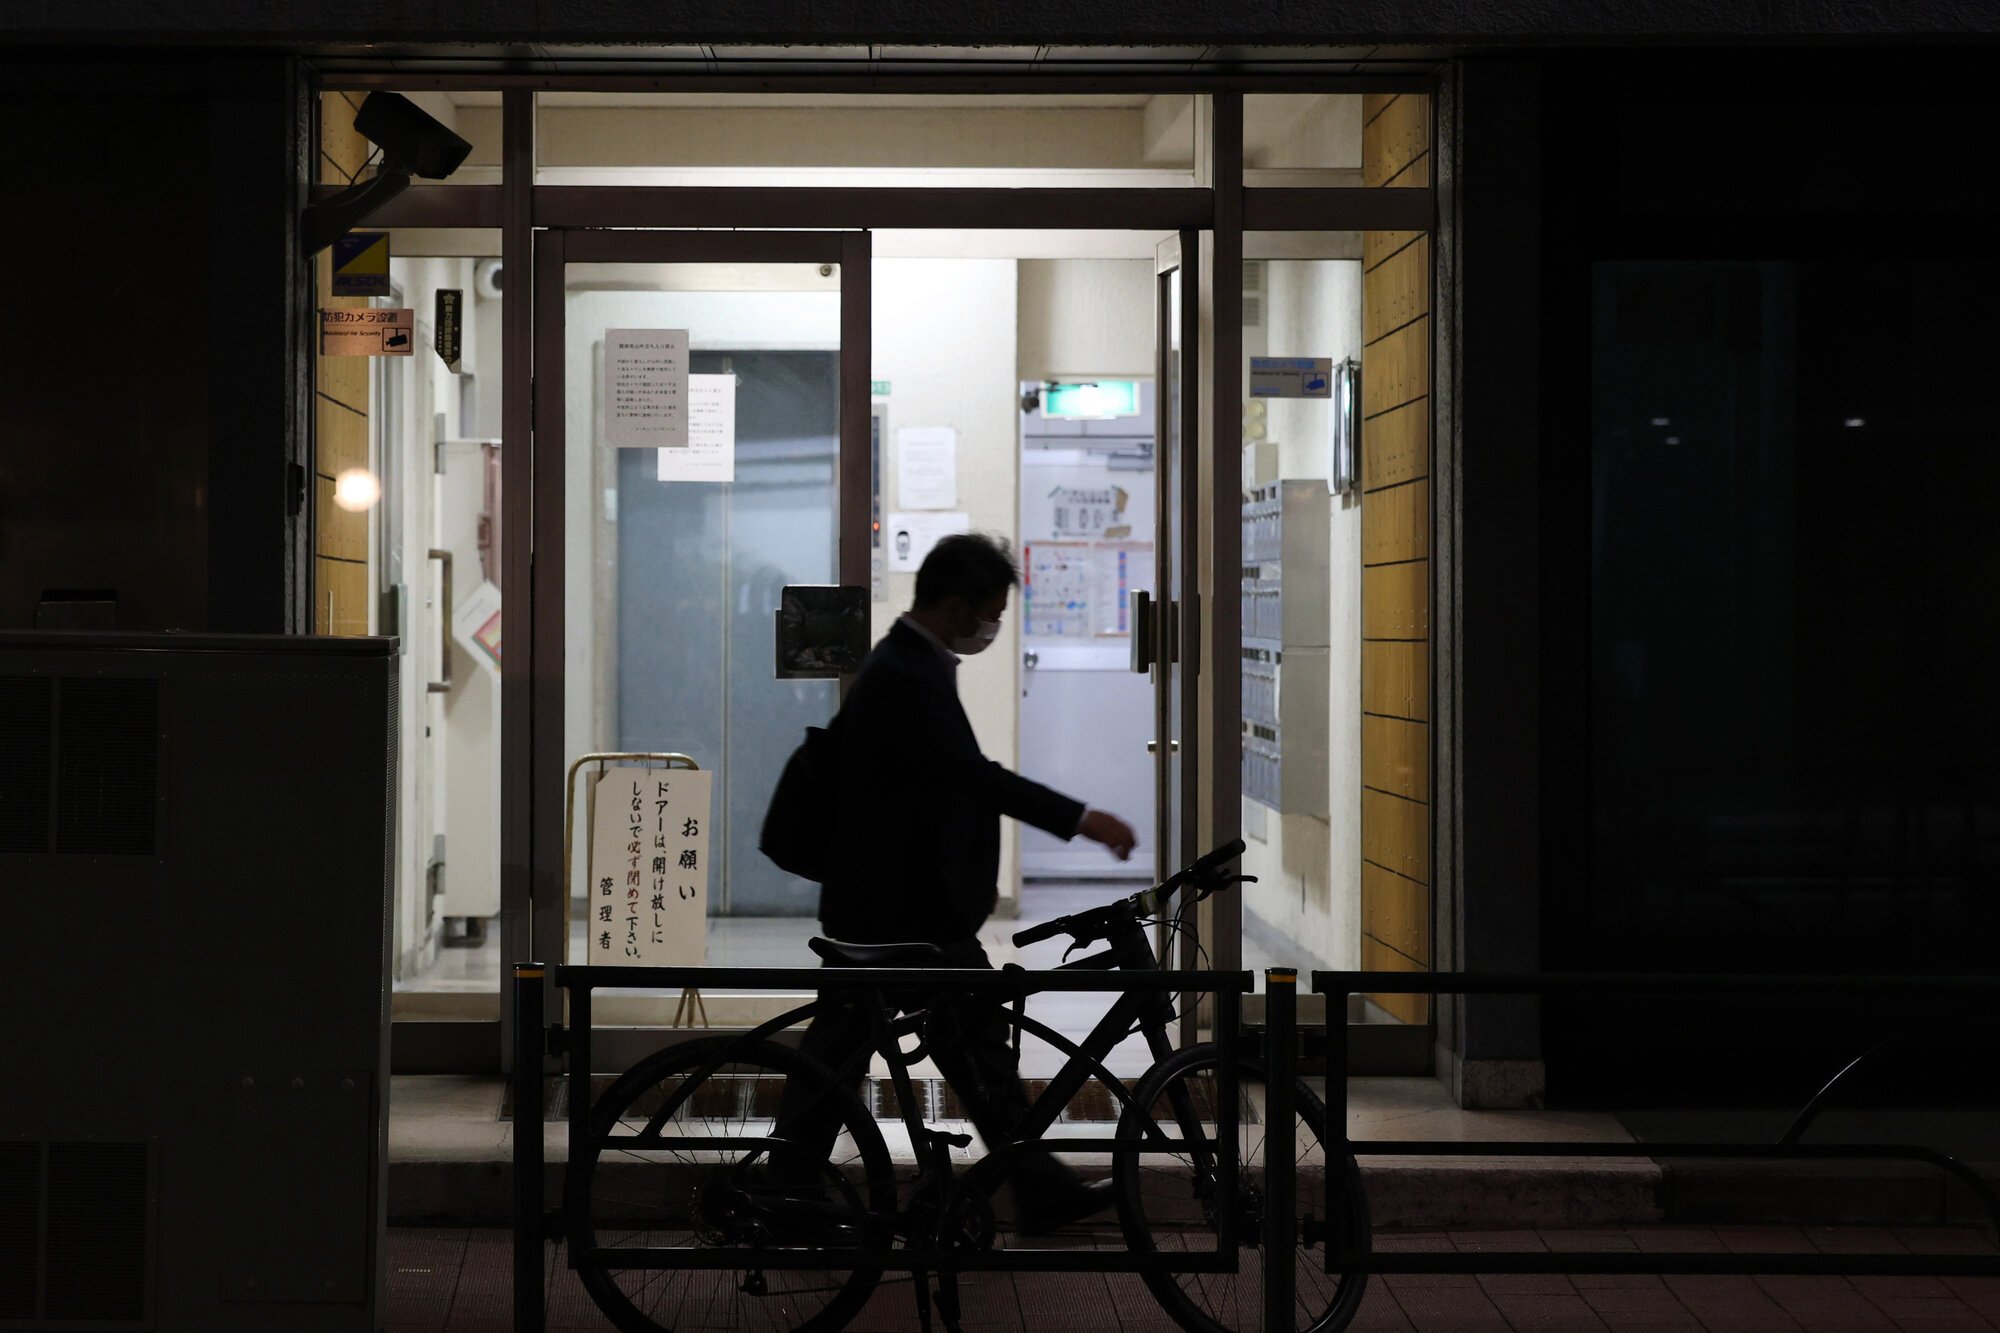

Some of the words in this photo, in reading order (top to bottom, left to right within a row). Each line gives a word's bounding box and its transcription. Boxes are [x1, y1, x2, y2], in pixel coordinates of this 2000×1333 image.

[323, 311, 398, 323] 防犯カメラ設置
[625, 781, 643, 959] しないで必ず閉めて下さい。
[650, 781, 669, 944] ドアーは、開け放しに
[678, 816, 699, 900] お願い
[598, 877, 614, 950] 管理者
